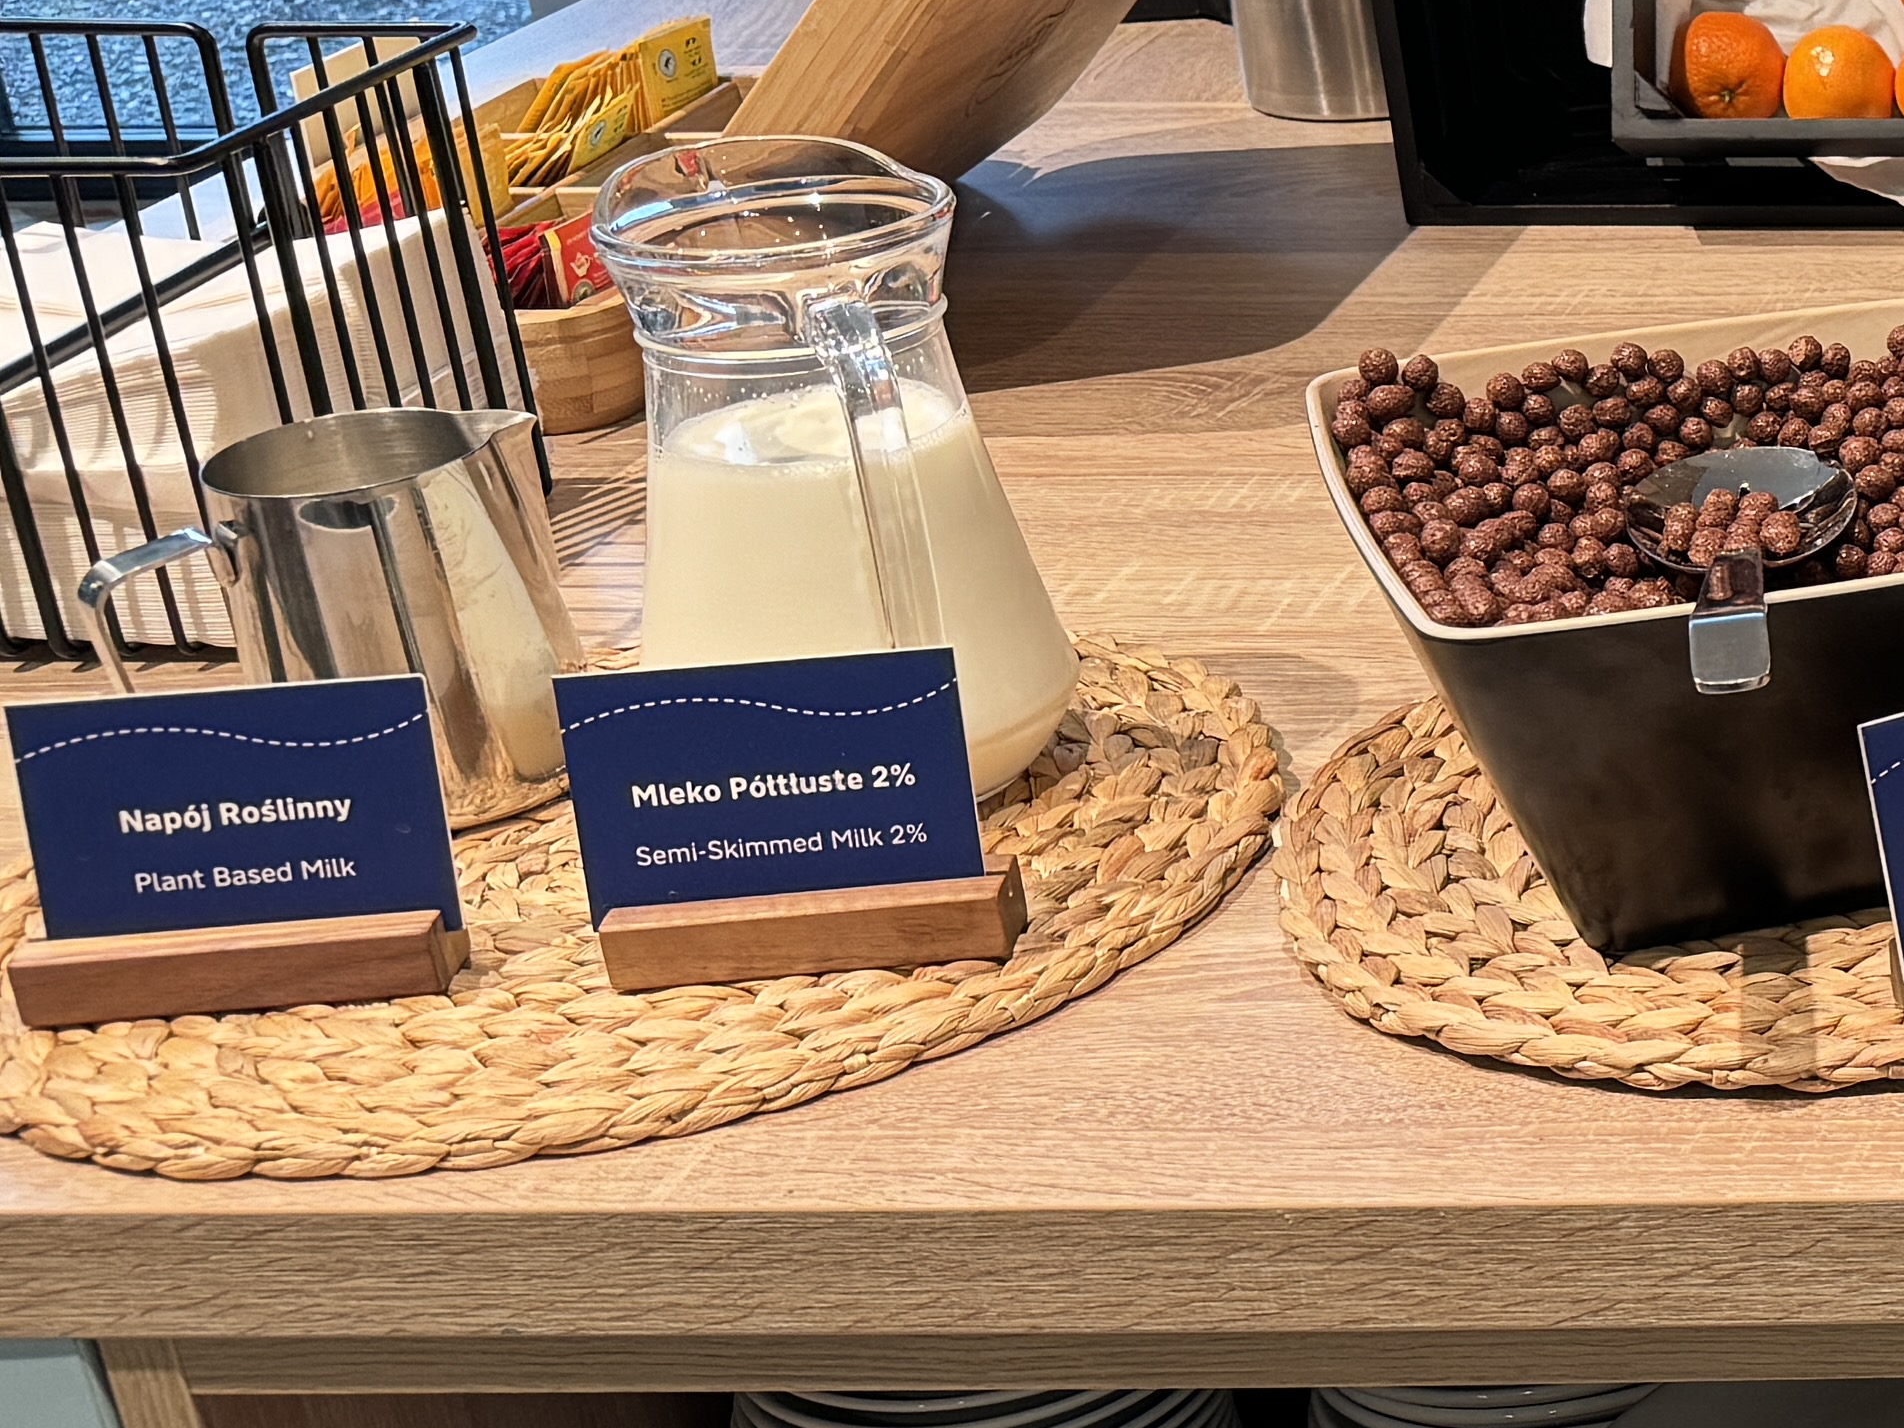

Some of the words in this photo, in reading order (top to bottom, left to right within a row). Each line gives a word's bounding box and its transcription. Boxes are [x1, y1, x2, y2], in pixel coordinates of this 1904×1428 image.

[631, 781, 722, 809] Mleko
[729, 769, 864, 800] Półtłuste
[871, 762, 917, 788] 2%
[118, 803, 212, 835] Napój
[218, 797, 352, 826] Roślinny
[635, 831, 824, 867] Semi-Skimmed
[831, 827, 884, 849] Milk
[889, 822, 928, 846] 2%
[133, 869, 207, 893] Plant
[212, 861, 293, 888] Based
[300, 857, 357, 880] Milk
